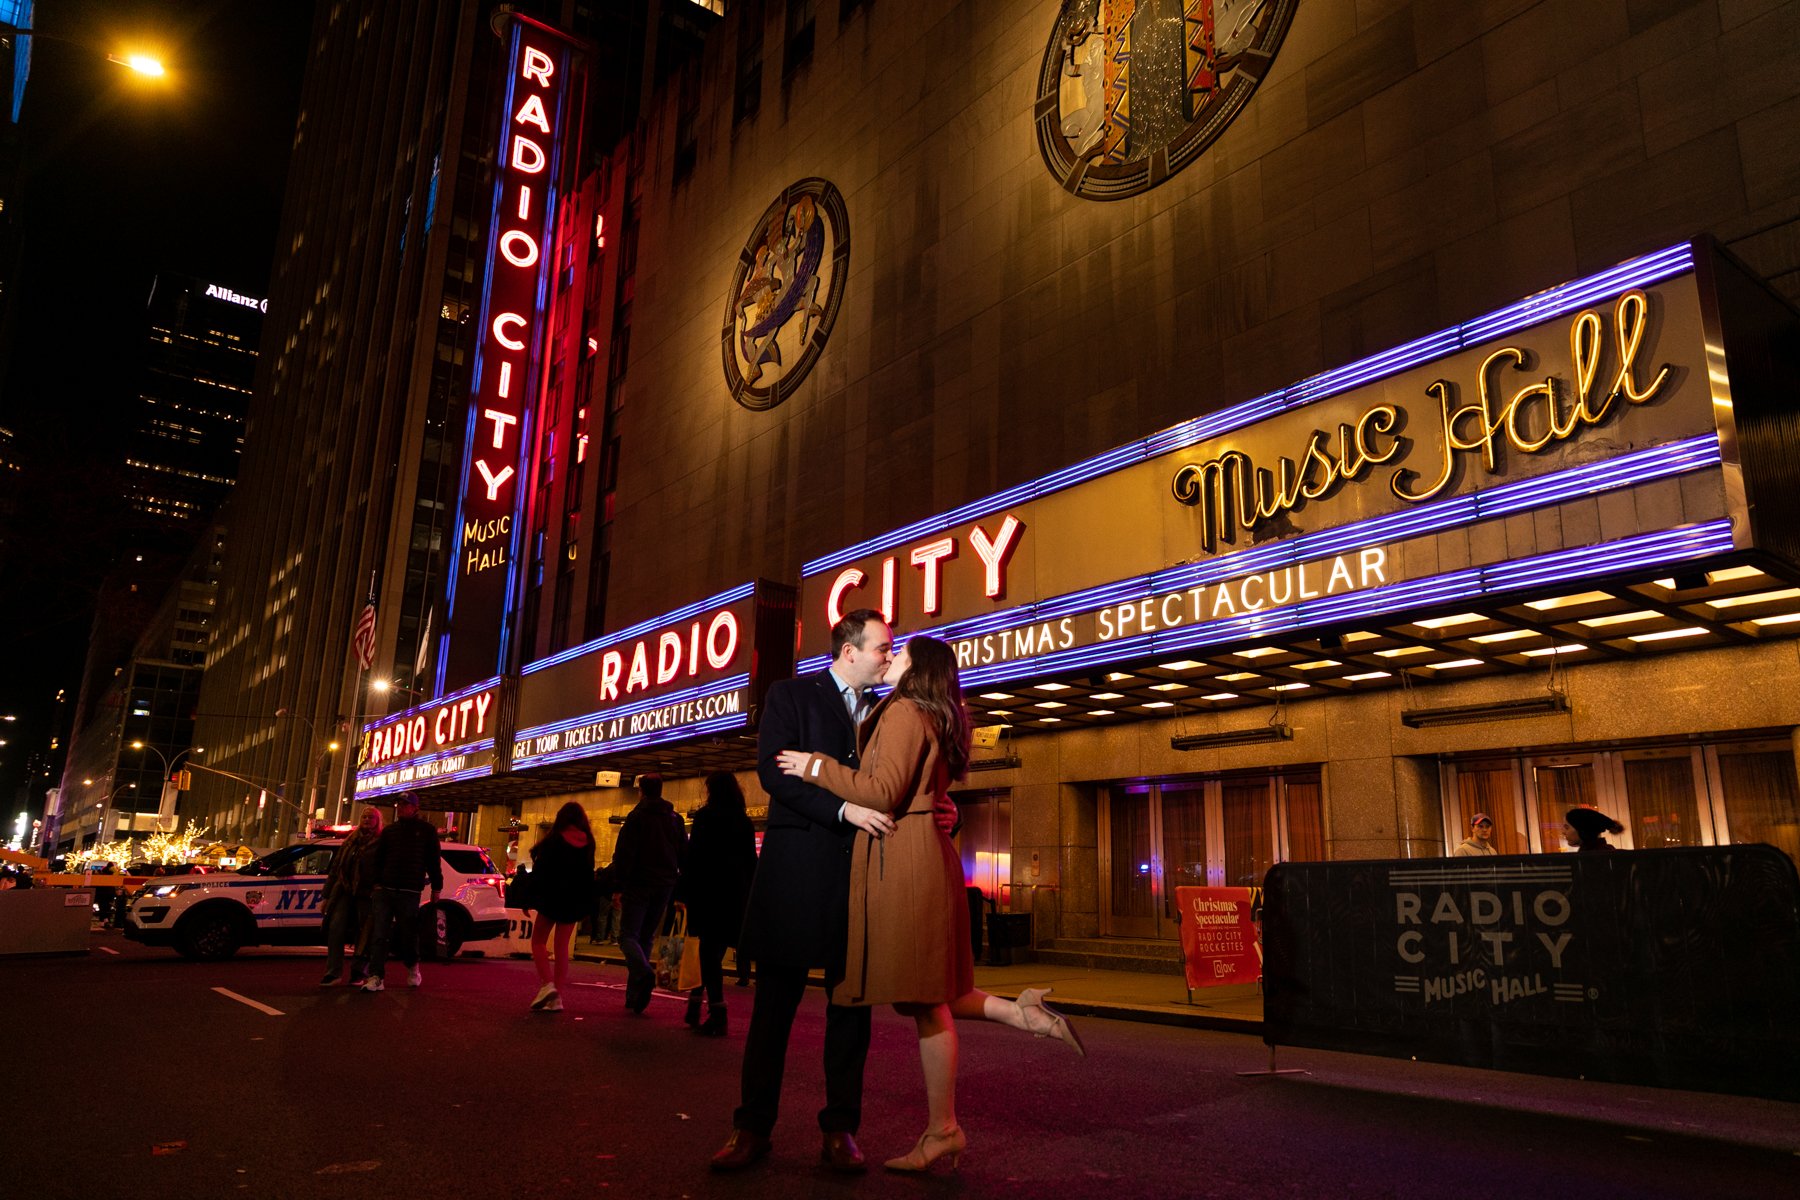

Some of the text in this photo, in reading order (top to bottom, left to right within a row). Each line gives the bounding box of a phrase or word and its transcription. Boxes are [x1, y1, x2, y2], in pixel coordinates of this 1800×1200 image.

[475, 46, 554, 501] RADIO CITY
[205, 283, 259, 309] Allianz
[1172, 287, 1673, 552] Music Hall
[464, 515, 510, 576] MUSIC HALL
[827, 513, 1022, 629] CITY
[952, 547, 1386, 669] RISTMAS SPECTACULAR
[599, 610, 739, 702] RADIO
[371, 715, 427, 764] RADIO
[434, 691, 492, 746] CITY
[536, 733, 561, 754] YOUR
[564, 722, 605, 749] TICKETS
[609, 718, 625, 739] AT
[630, 690, 740, 734] ROCKETTES.COM
[200, 881, 231, 889] POLICE
[275, 889, 325, 910] NYP
[1193, 897, 1238, 911] Christmas
[1195, 912, 1239, 929] Spectacular
[1395, 889, 1572, 927] RADIO
[1199, 931, 1242, 941] RADIO CITY
[1200, 942, 1243, 952] ROCKETTES
[1396, 930, 1573, 969] CITY
[1424, 968, 1548, 1006] MUSIC HALL
